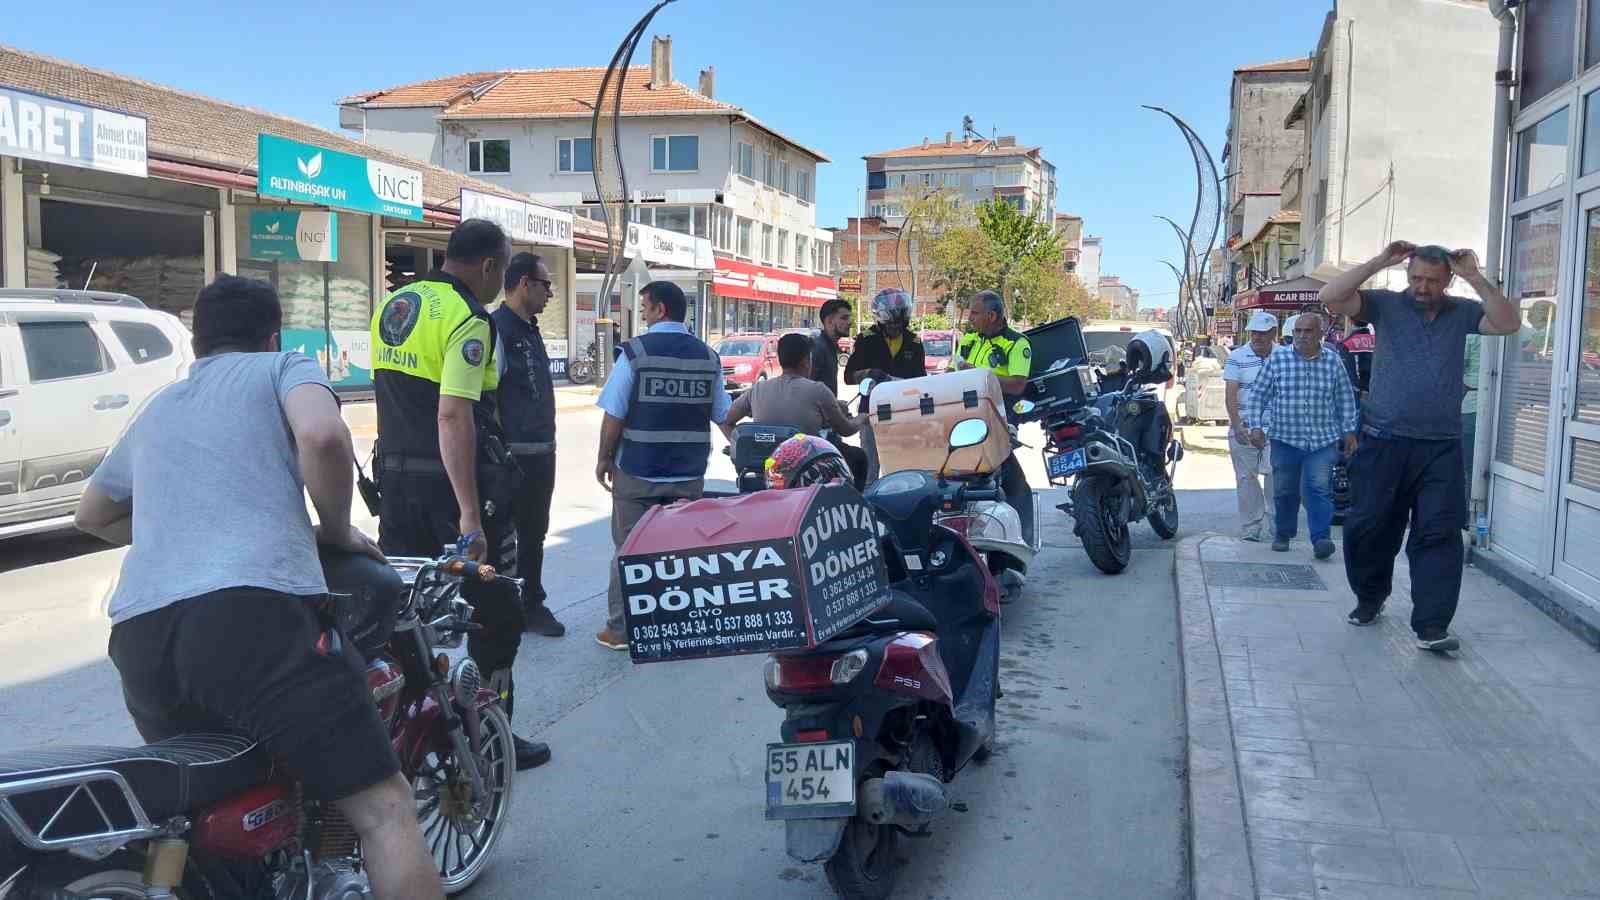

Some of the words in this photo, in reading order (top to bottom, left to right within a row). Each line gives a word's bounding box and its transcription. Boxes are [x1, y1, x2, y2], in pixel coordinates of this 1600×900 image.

[270, 177, 331, 198] ALTINBAŞAK
[331, 187, 347, 200] UN
[377, 168, 415, 201] İNCİ
[527, 213, 554, 237] GÜVEN
[1274, 293, 1298, 302] ACAR
[377, 348, 418, 369] MSUN
[802, 503, 875, 560] DÜNYA
[624, 546, 787, 585] DÜNYA
[810, 538, 880, 587] DÖNER
[628, 578, 793, 616] DÖNER
[634, 626, 640, 640] 0
[643, 624, 659, 639] 362
[661, 622, 679, 637] 543
[681, 621, 694, 635] 34
[695, 619, 707, 634] 34
[715, 617, 722, 632] 0
[725, 615, 741, 630] 537
[744, 613, 763, 628] 888
[766, 612, 771, 626] 1
[774, 610, 793, 625] 333
[637, 643, 648, 654] Ev
[673, 637, 714, 650] Yerlerine
[715, 632, 764, 646] Servisimiz
[894, 675, 921, 689] PS3
[771, 750, 799, 775] 55
[804, 747, 850, 772] ALN
[786, 776, 830, 801] 454
